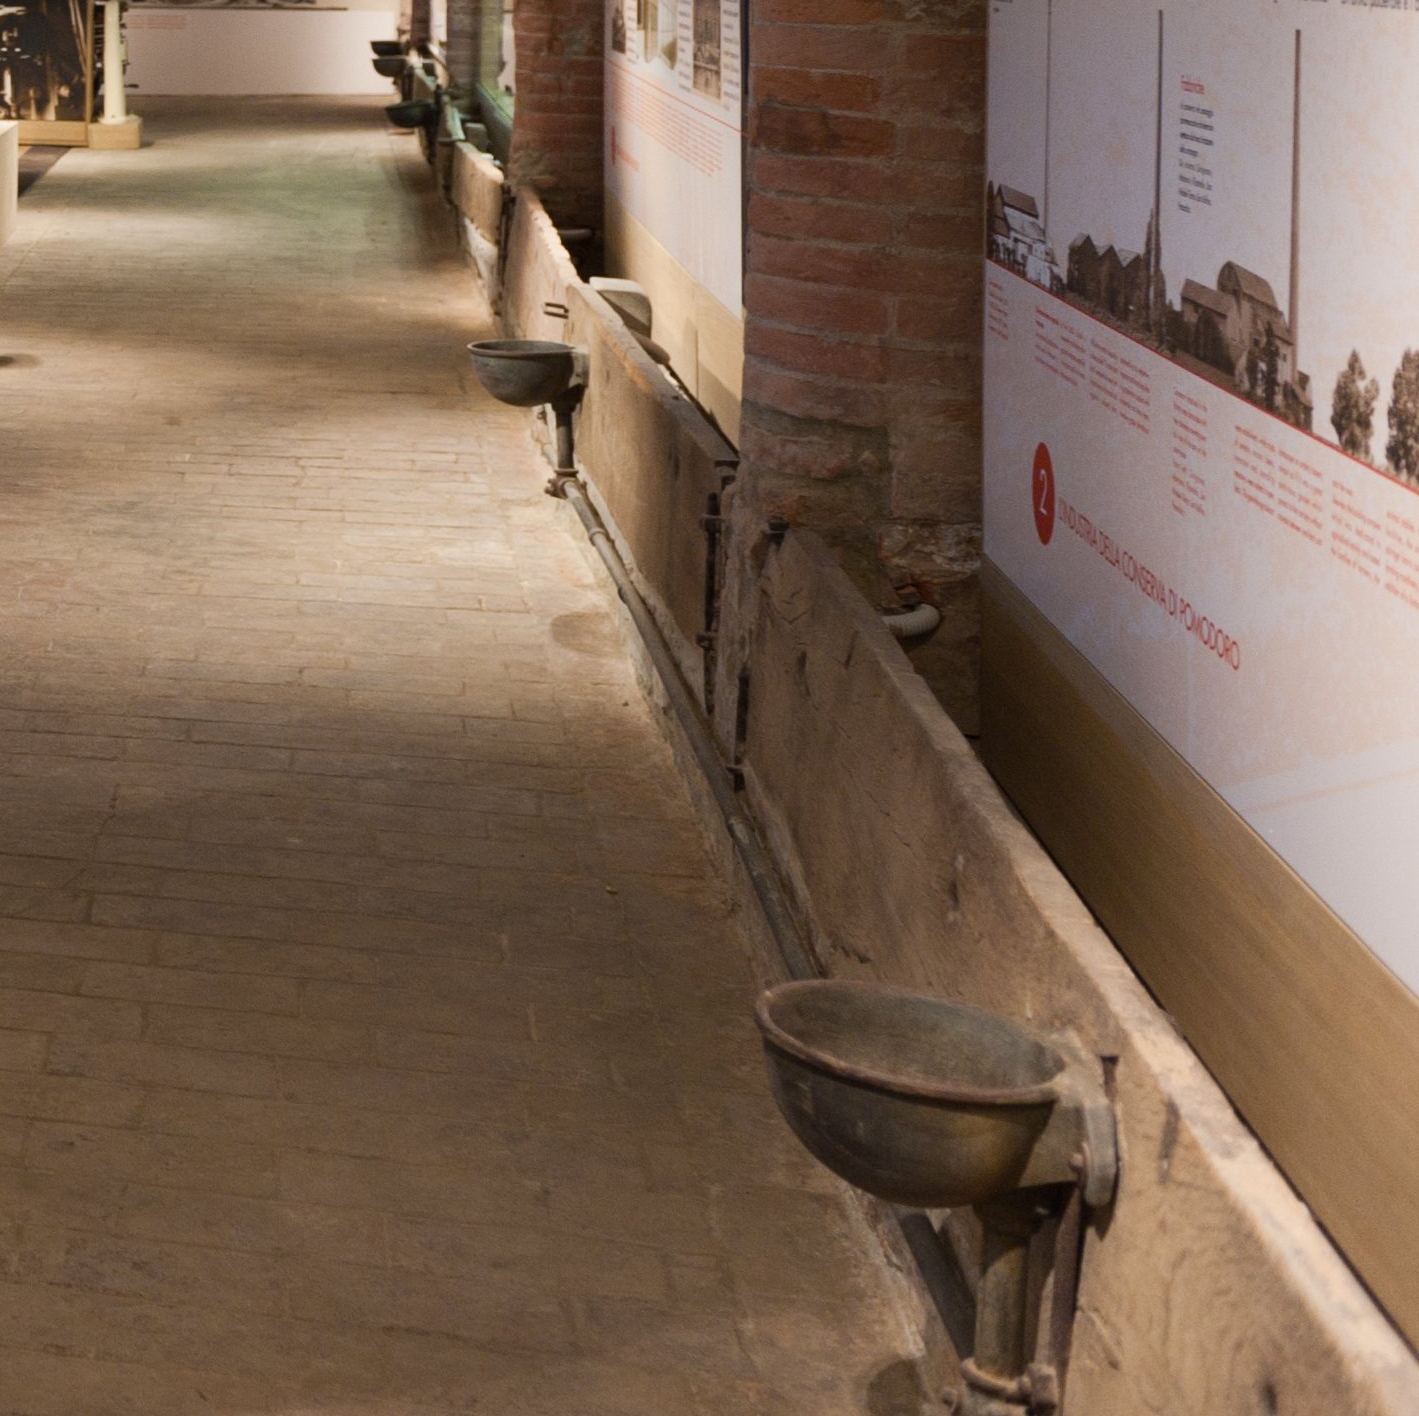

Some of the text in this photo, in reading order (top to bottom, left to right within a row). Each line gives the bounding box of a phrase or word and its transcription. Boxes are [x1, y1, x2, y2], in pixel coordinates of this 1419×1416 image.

[1039, 468, 1048, 516] 2
[1168, 587, 1178, 621] DI
[1179, 596, 1240, 671] POMODORO
